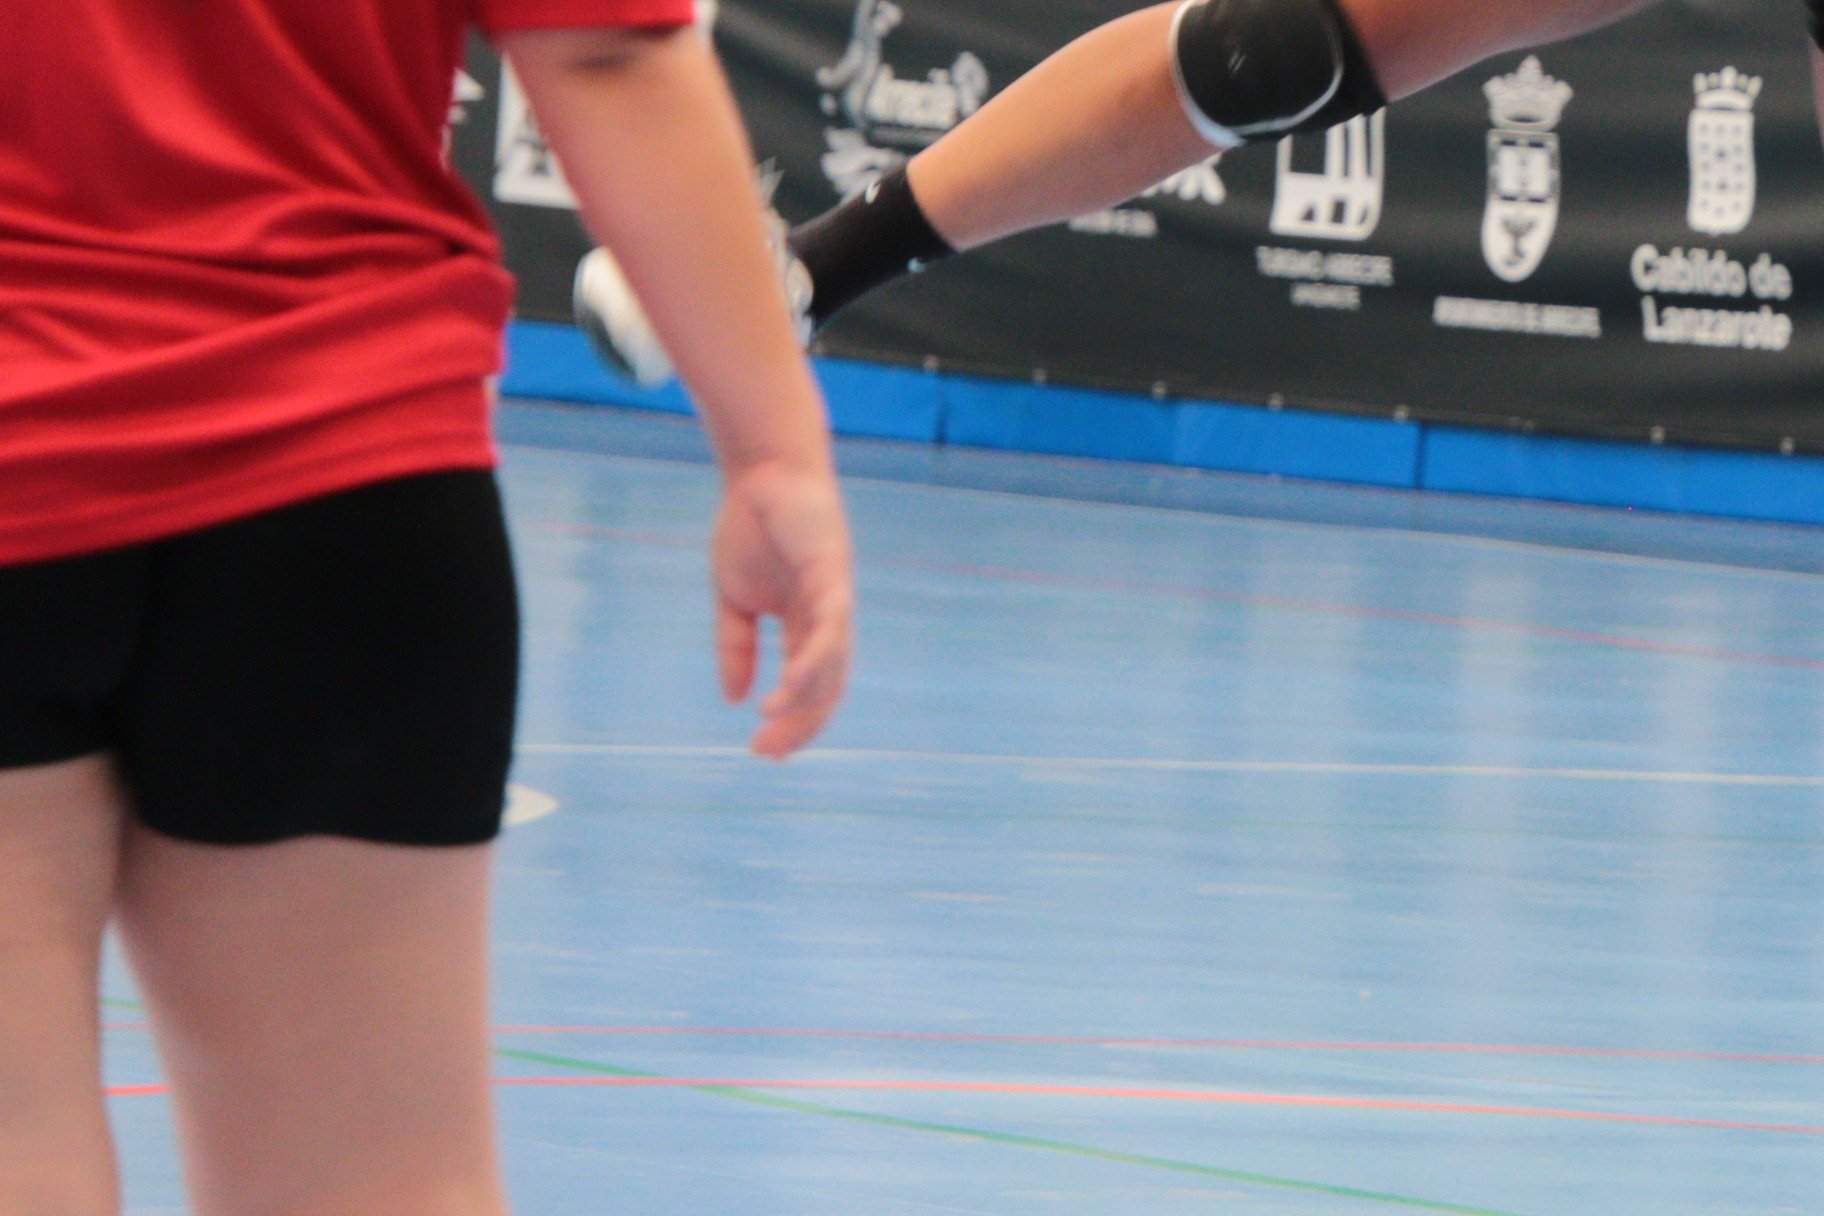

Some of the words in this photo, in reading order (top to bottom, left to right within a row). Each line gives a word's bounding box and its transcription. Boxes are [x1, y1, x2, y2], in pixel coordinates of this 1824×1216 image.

[1630, 242, 1748, 298] Cabildo
[1749, 252, 1792, 301] de
[1641, 294, 1793, 352] Lanzarote
